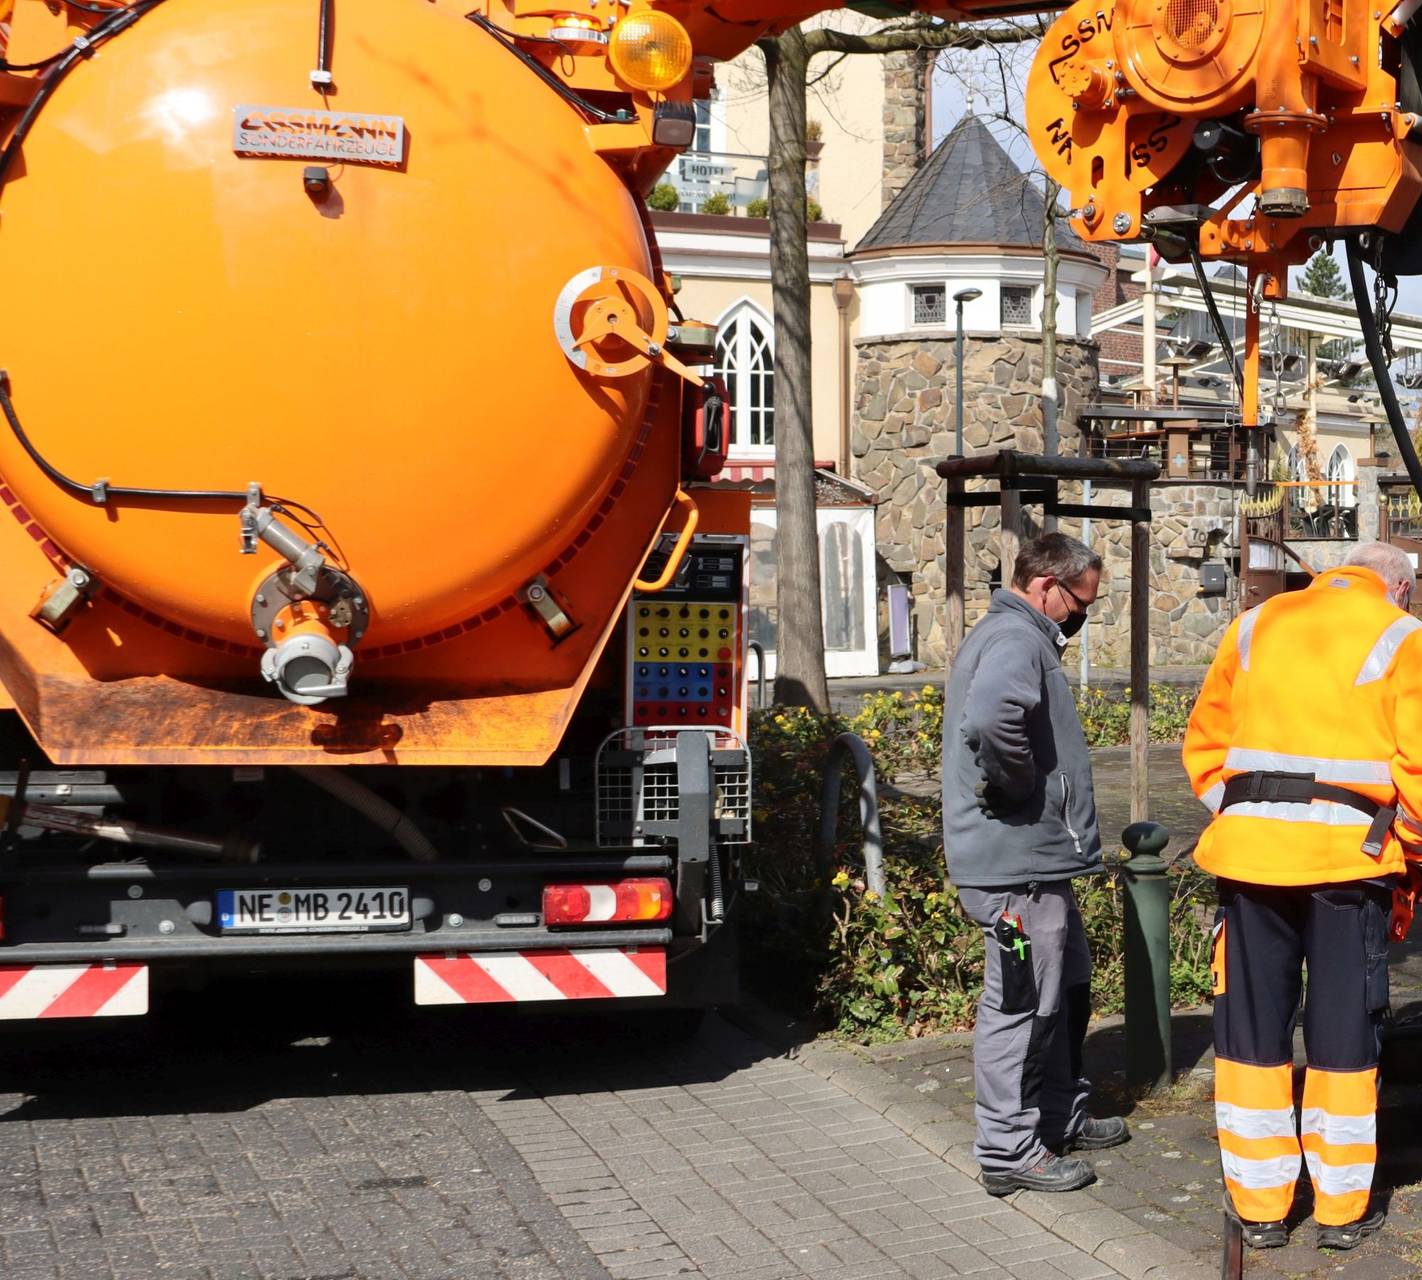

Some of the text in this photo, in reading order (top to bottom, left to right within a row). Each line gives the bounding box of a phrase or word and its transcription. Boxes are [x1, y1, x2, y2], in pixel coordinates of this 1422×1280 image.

[239, 132, 397, 157] SONDERFAHRZEUGE
[1191, 527, 1207, 543] 70
[239, 894, 274, 923] NE
[294, 893, 330, 921] MB
[336, 891, 405, 921] 2410
